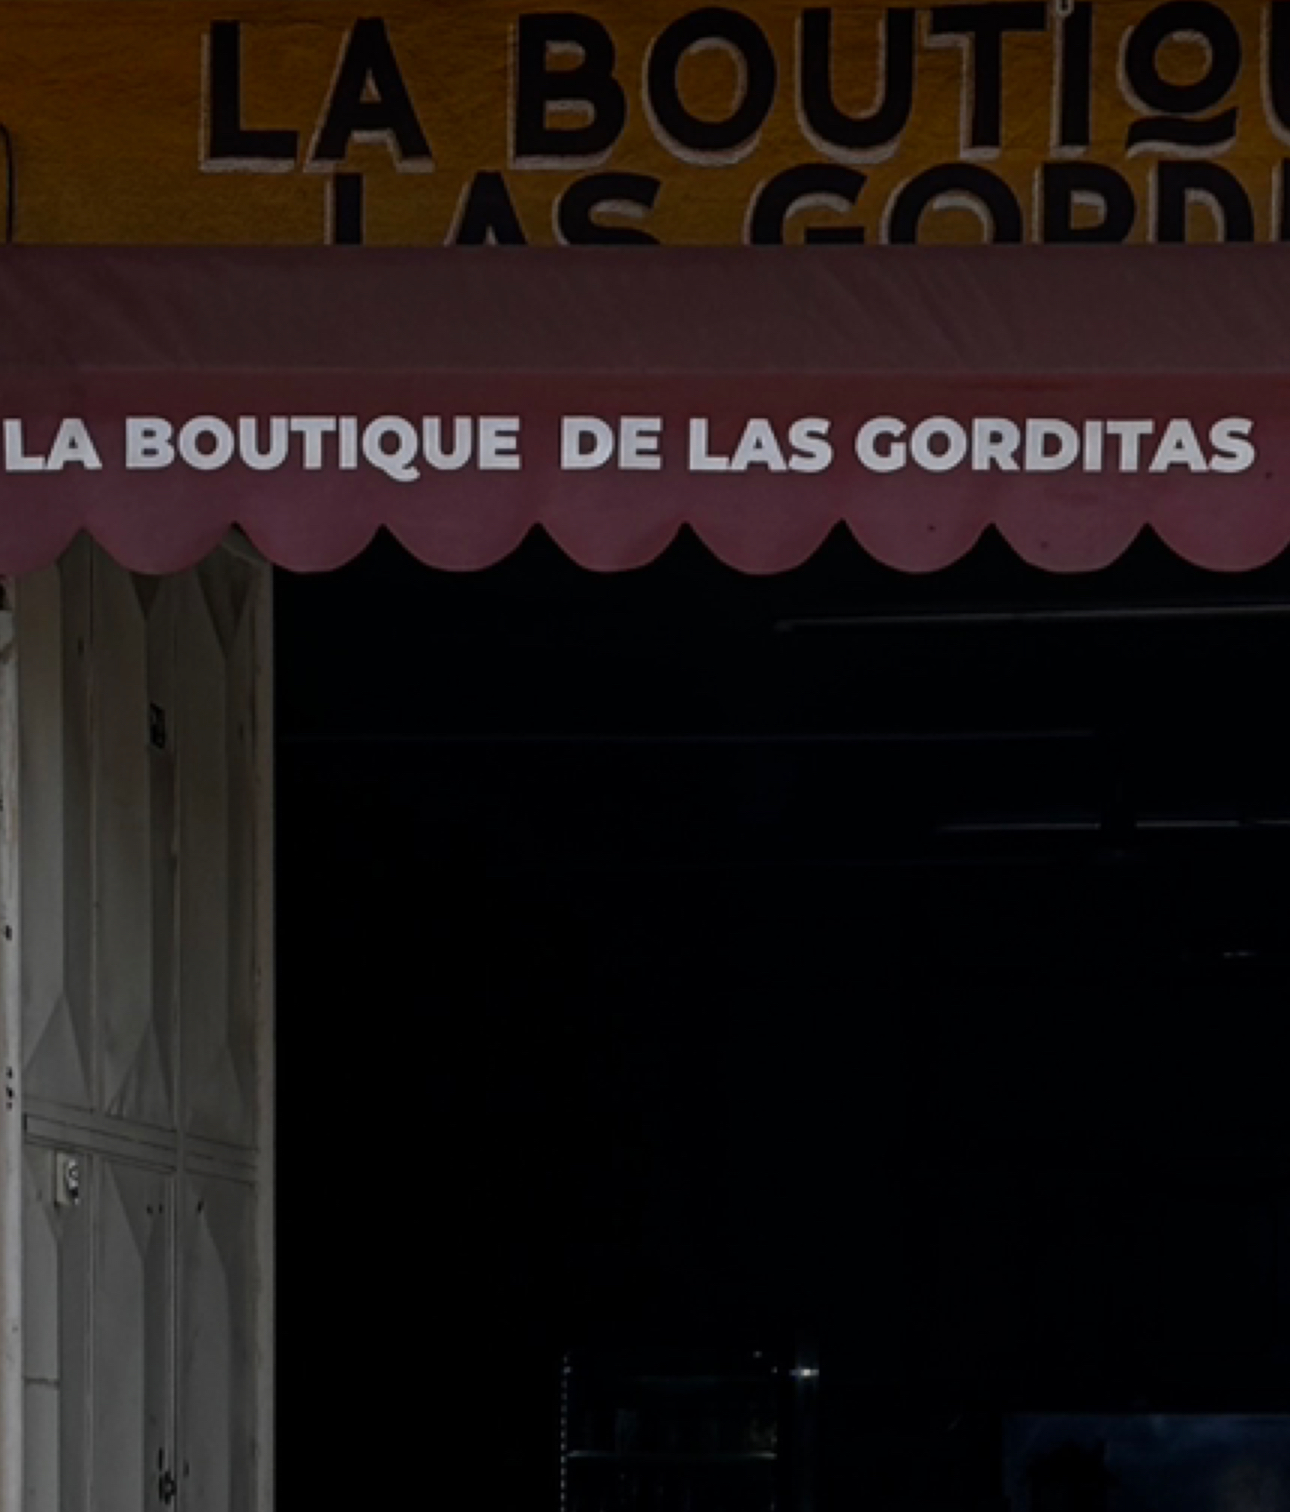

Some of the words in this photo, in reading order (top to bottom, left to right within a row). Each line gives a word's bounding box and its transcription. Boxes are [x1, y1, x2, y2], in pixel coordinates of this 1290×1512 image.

[199, 17, 434, 173] LA
[3, 417, 101, 472] LA
[126, 415, 521, 482] BOUTIQUE
[559, 416, 663, 470] DE
[689, 416, 833, 475] LAS
[855, 416, 1255, 475] GORDITAS
